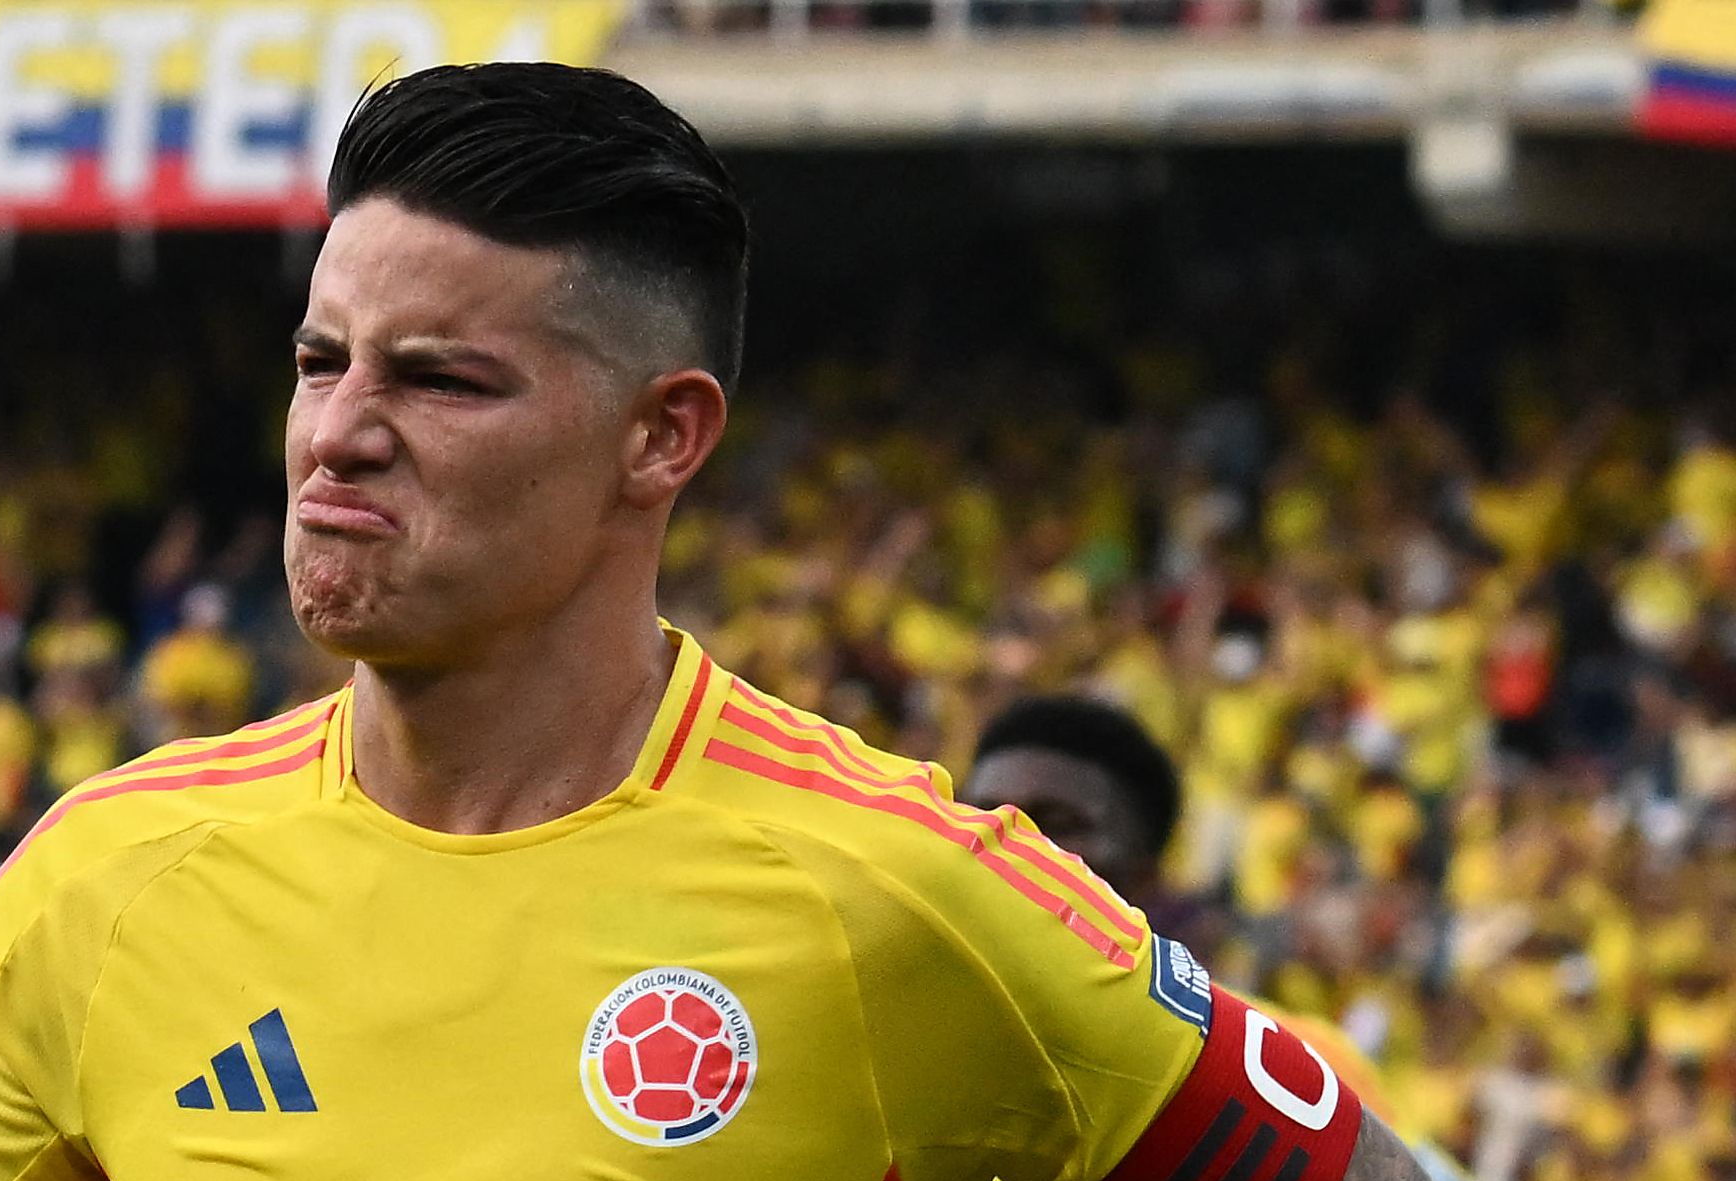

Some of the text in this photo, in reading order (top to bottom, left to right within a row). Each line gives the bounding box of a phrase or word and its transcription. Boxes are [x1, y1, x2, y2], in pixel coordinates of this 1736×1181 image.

[635, 973, 716, 999] COLOMBIANA
[714, 993, 731, 1011] DE
[726, 1008, 751, 1057] FUTBOL
[1244, 1008, 1340, 1131] C
